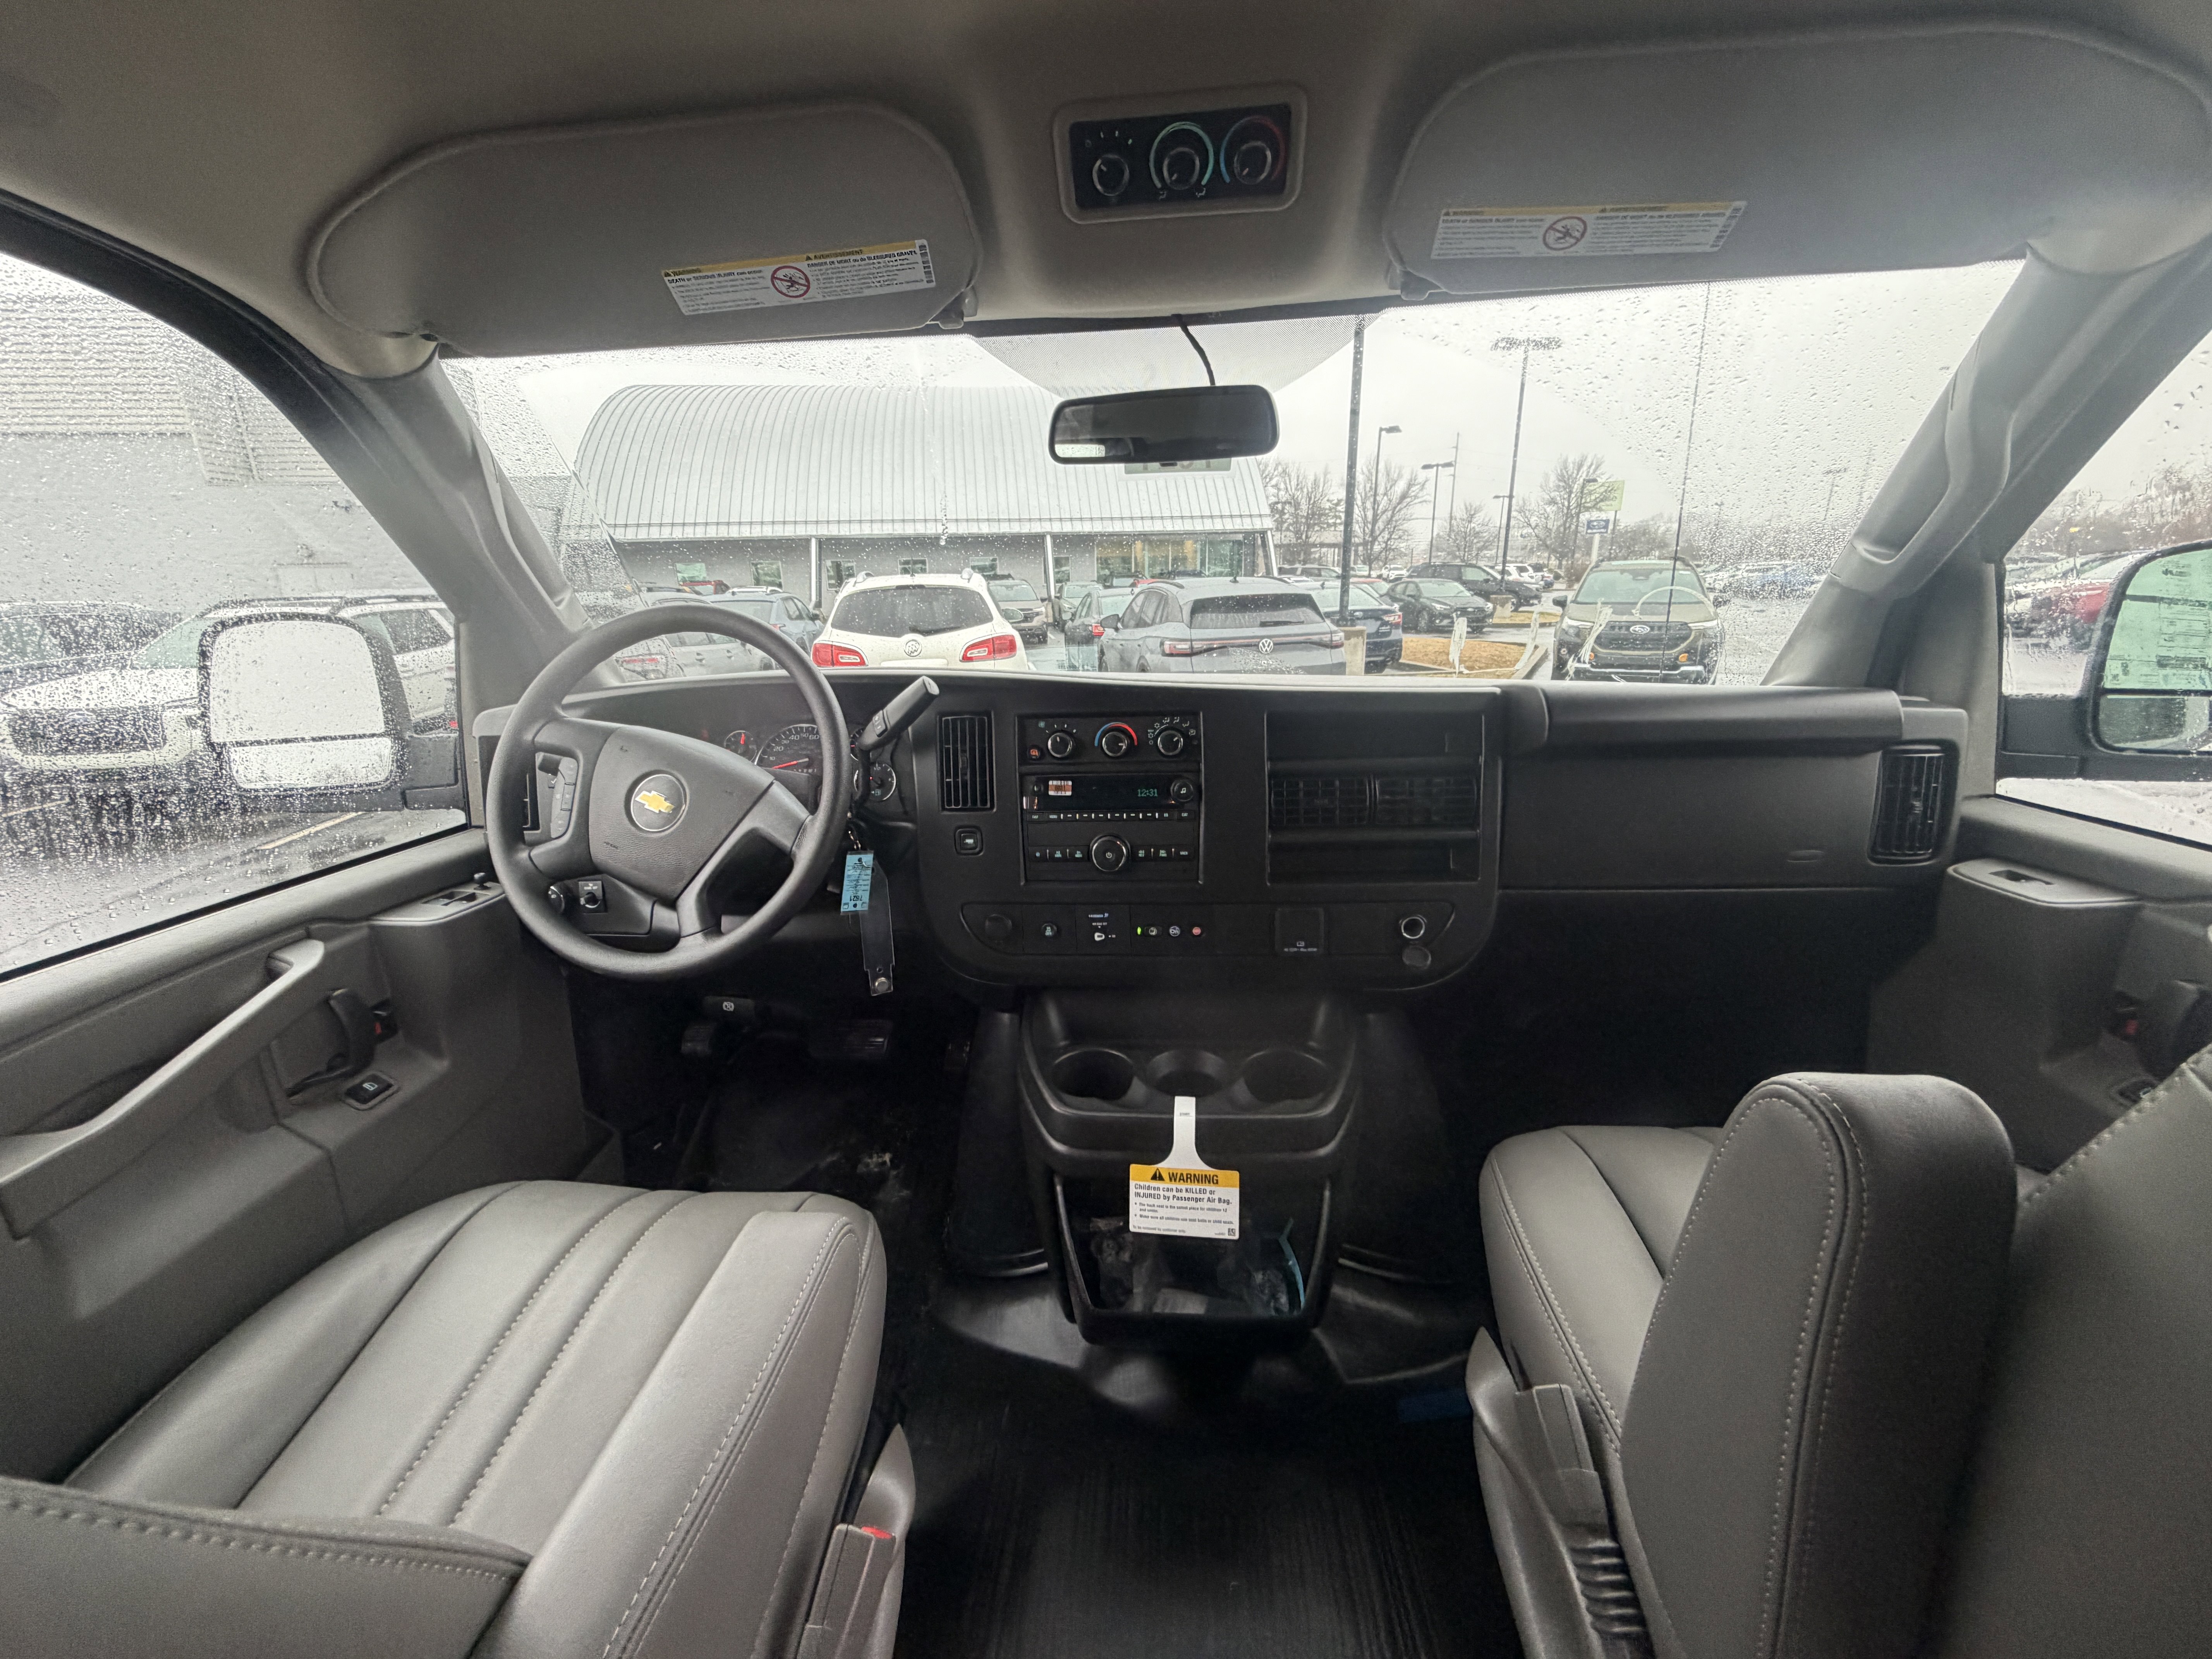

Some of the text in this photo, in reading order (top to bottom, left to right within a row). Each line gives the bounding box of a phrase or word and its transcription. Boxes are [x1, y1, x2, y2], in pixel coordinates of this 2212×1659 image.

[1137, 789, 1158, 797] 12:31
[1168, 1172, 1219, 1185] WARNING
[1135, 1183, 1160, 1192] Children
[1135, 1192, 1161, 1200] INJURED
[1172, 1195, 1205, 1203] Passenger
